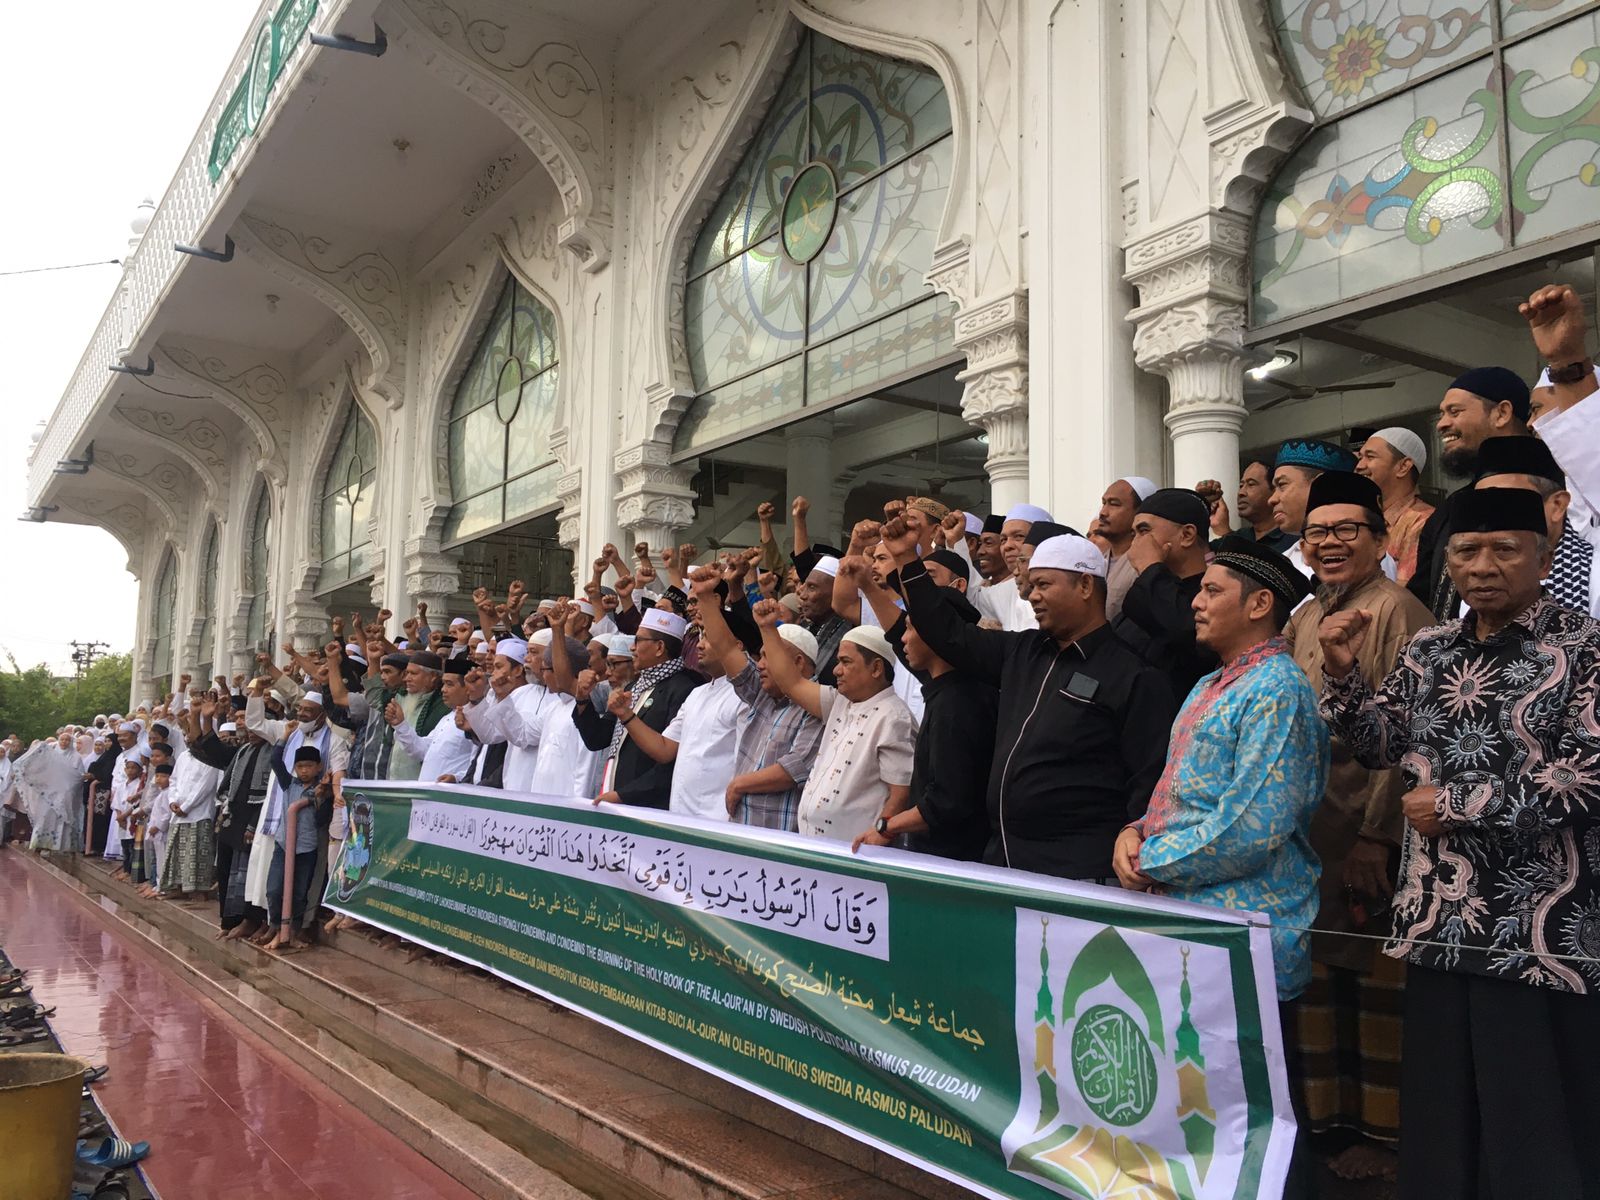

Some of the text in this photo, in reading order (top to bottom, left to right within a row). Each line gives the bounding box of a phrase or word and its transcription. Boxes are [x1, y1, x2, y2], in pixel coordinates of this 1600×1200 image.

[498, 915, 520, 933] STRONGLY
[520, 922, 546, 942] CONDEMNS
[545, 931, 556, 945] AND
[556, 935, 586, 956] CONDEMNS
[586, 944, 597, 960] THE
[597, 948, 623, 969] BURNING
[624, 957, 632, 972] OF
[632, 961, 645, 977] THE
[645, 965, 663, 983] HOLY
[663, 971, 684, 992] BOOK
[684, 979, 695, 995] OF
[696, 982, 711, 1001] THE
[710, 988, 755, 1017] AL-QUR'AN
[756, 1002, 769, 1021] BY
[769, 1007, 809, 1037] SWEDISH
[809, 1023, 860, 1058] POLITICIAN
[859, 1044, 910, 1077] RASMUS
[909, 1063, 982, 1102] PULUDAN
[753, 953, 784, 985] كوتا
[927, 1001, 985, 1050] جماعة
[509, 946, 536, 969] MENGECAM
[536, 958, 548, 973] DAN
[547, 962, 577, 984] MENGUTUK
[578, 974, 599, 993] KERAS
[599, 983, 645, 1012] PEMBAKARAN
[645, 1001, 667, 1020] KITAB
[667, 1009, 686, 1029] SUCI
[686, 1018, 731, 1048] AL-QUR'AN
[732, 1035, 756, 1058] OLEH
[758, 1046, 808, 1080] POLITIKUS
[810, 1066, 853, 1099] SWEDIA
[855, 1083, 907, 1120] RASMUS
[909, 1105, 973, 1148] PALUDAN
